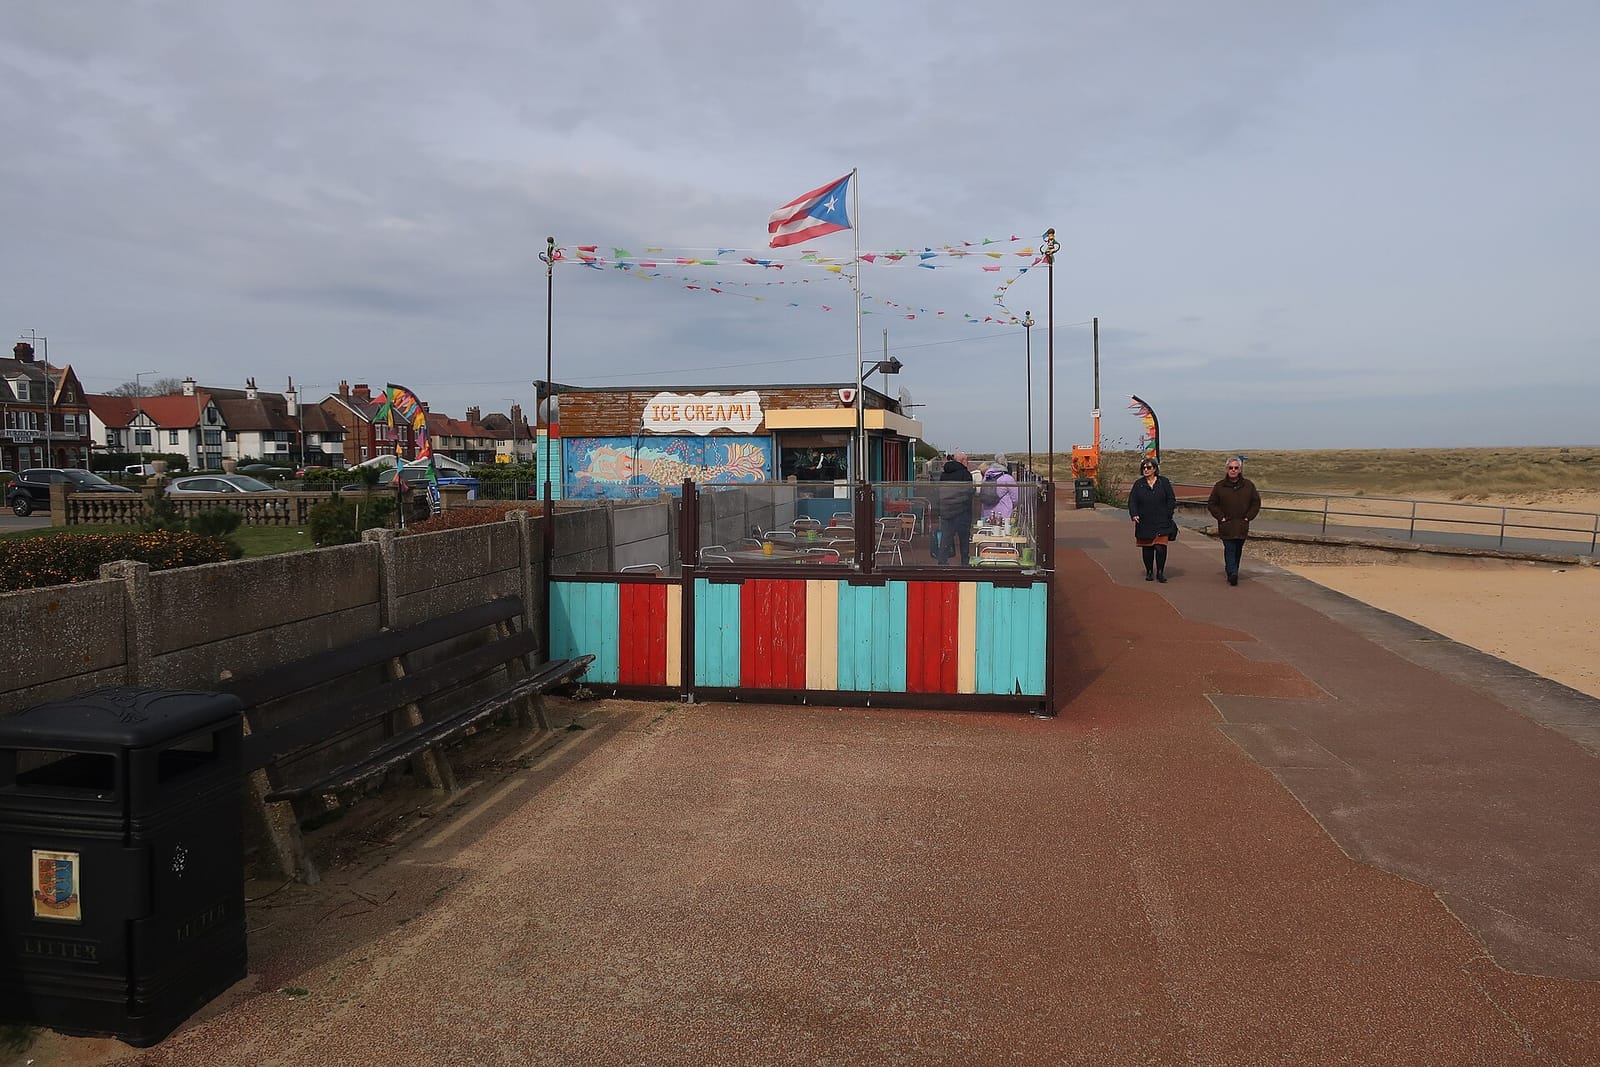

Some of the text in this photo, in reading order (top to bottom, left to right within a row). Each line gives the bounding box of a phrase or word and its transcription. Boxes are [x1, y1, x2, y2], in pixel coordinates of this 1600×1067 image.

[652, 404, 752, 421] ICE CREAM!
[25, 939, 97, 960] LITTER
